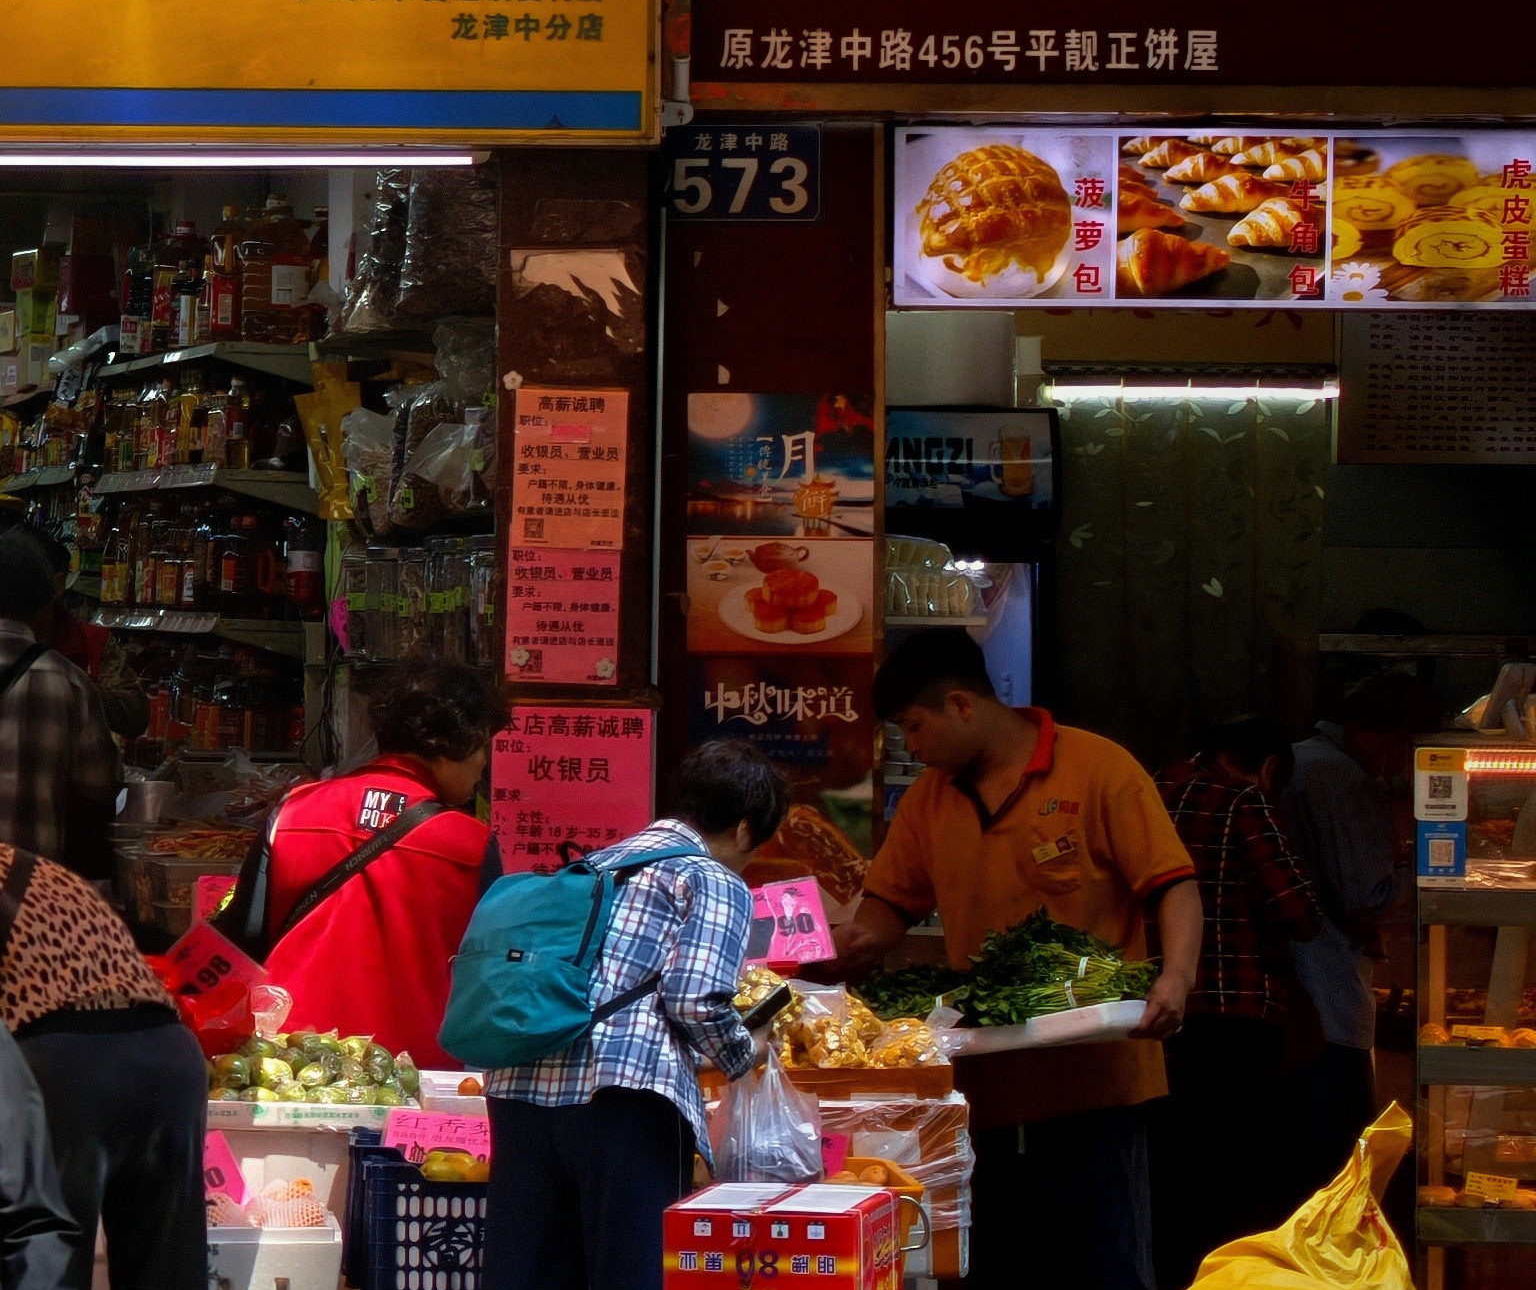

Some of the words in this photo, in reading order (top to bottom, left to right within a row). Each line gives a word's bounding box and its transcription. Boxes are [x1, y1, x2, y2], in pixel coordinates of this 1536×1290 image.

[451, 12, 604, 42] 龙津中分店
[720, 28, 1219, 72] 原龙津中路456号平靓正饼屋
[694, 132, 789, 152] 龙津中路
[673, 157, 808, 214] 573
[1073, 177, 1105, 295] 菠萝包
[1288, 179, 1320, 295] 牛角包
[1499, 157, 1533, 297] 虎皮蛋糕
[539, 396, 605, 413] 高薪诚聘
[521, 445, 619, 459] 收银员、营业员
[704, 681, 860, 725] 中秋味道
[505, 714, 645, 739] 本店高薪诚聘
[529, 755, 610, 783] 收银员
[364, 790, 392, 811] MY
